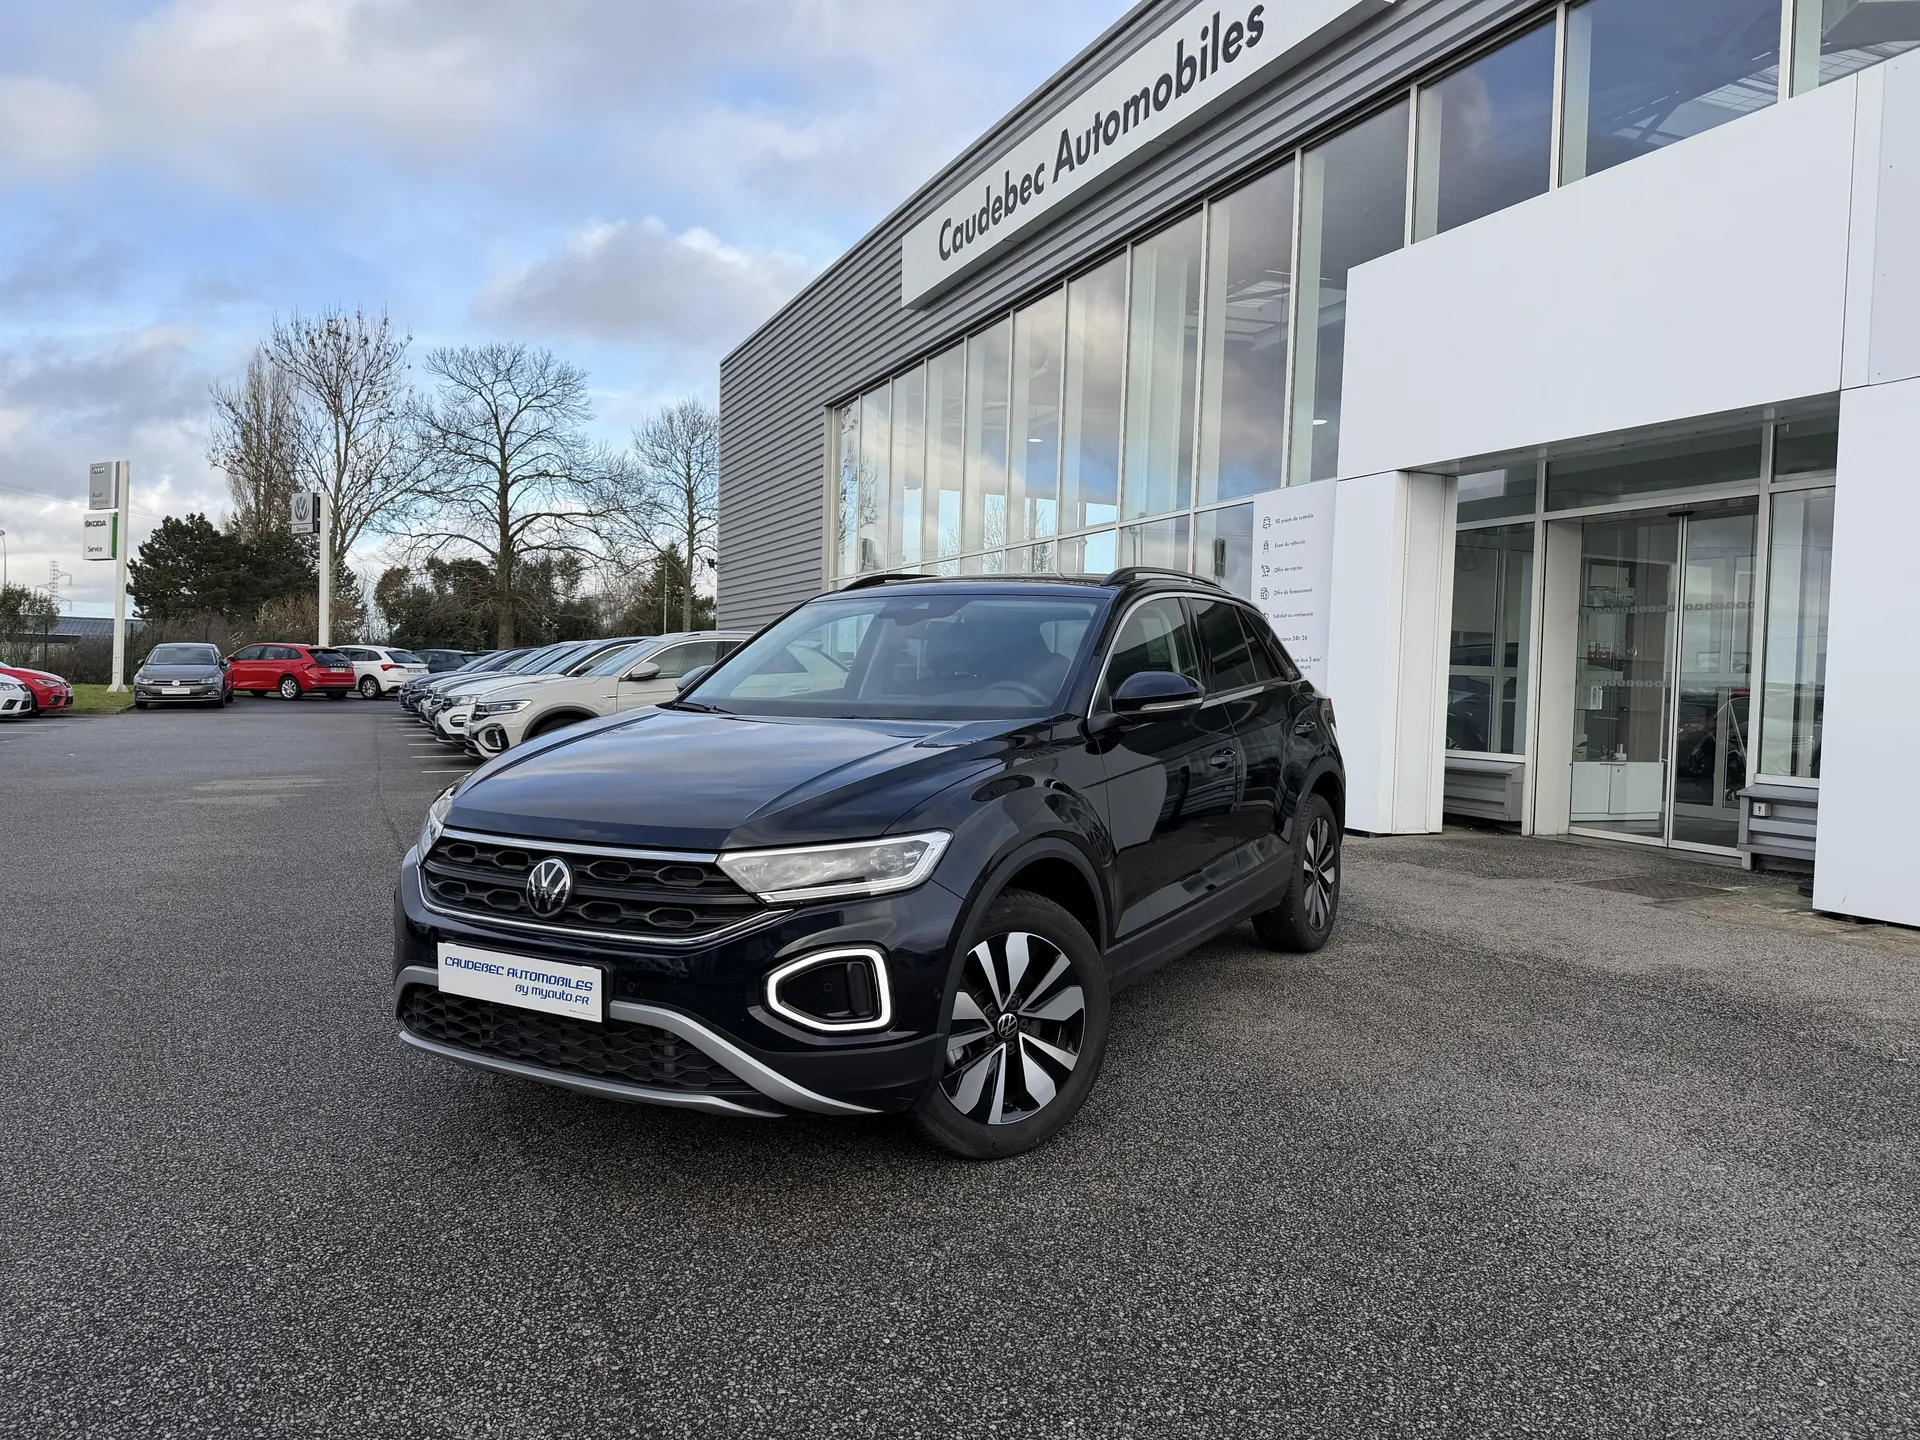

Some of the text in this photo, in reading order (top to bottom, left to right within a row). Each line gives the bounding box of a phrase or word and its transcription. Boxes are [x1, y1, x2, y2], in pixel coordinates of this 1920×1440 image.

[938, 3, 1266, 263] Caudebec Automobiles
[444, 956, 593, 992] CAUDEBEC AUTOMOBILES
